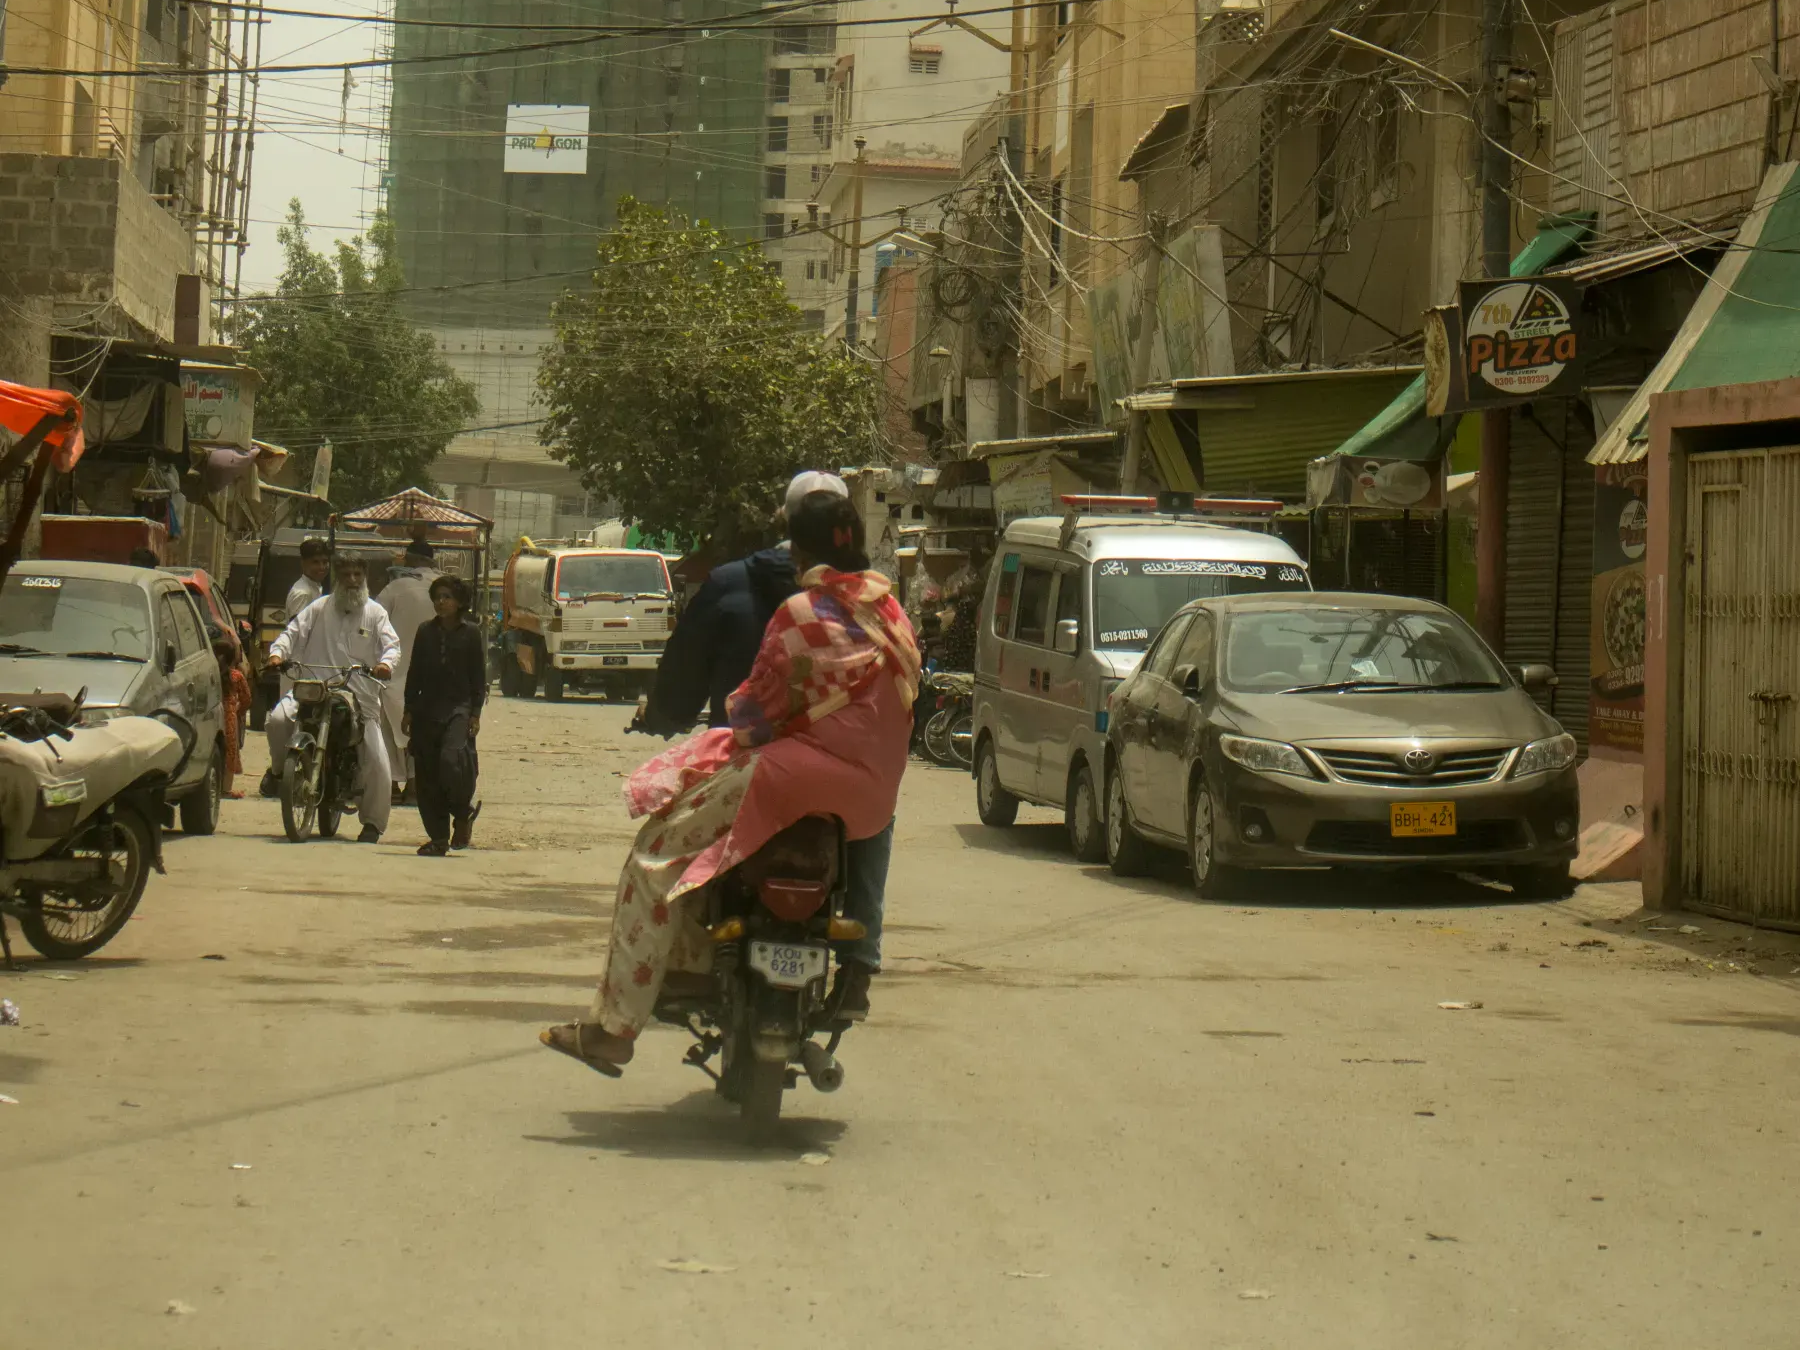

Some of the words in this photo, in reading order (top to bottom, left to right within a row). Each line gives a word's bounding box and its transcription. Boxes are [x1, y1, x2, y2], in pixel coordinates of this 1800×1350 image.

[701, 29, 709, 38] 10
[1480, 303, 1512, 325] 7th
[1513, 327, 1551, 339] STREET
[1469, 332, 1577, 374] Pizza
[771, 959, 805, 975] 6281
